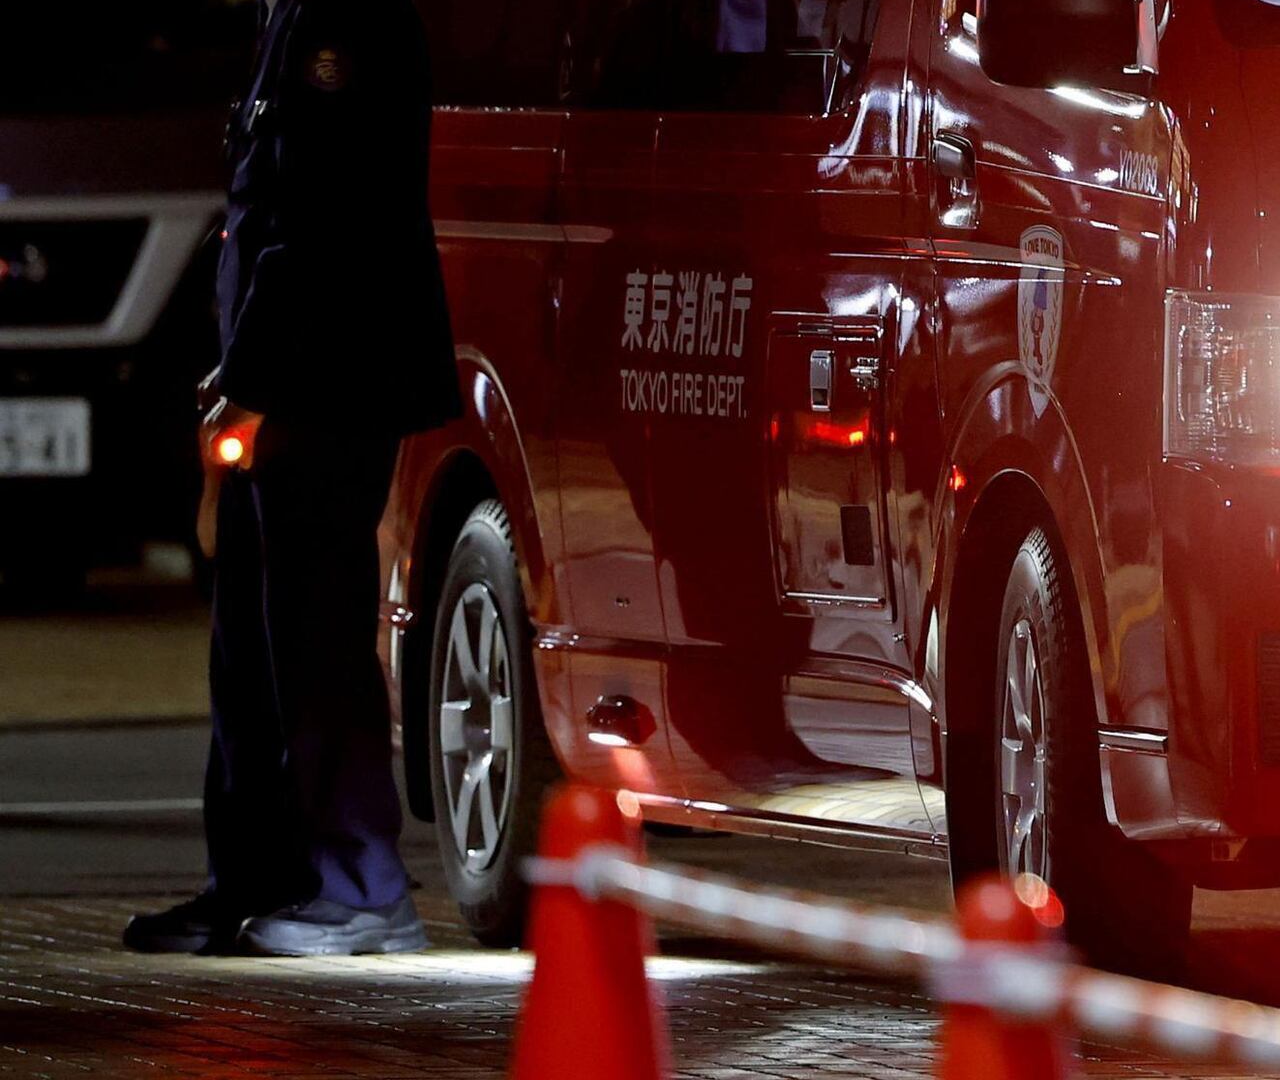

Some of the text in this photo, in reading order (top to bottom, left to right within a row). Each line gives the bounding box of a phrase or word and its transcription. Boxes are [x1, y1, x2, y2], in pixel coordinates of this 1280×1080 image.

[621, 268, 753, 358] 東京消防庁
[620, 369, 747, 418] TOKYO FIRE DEPT.
